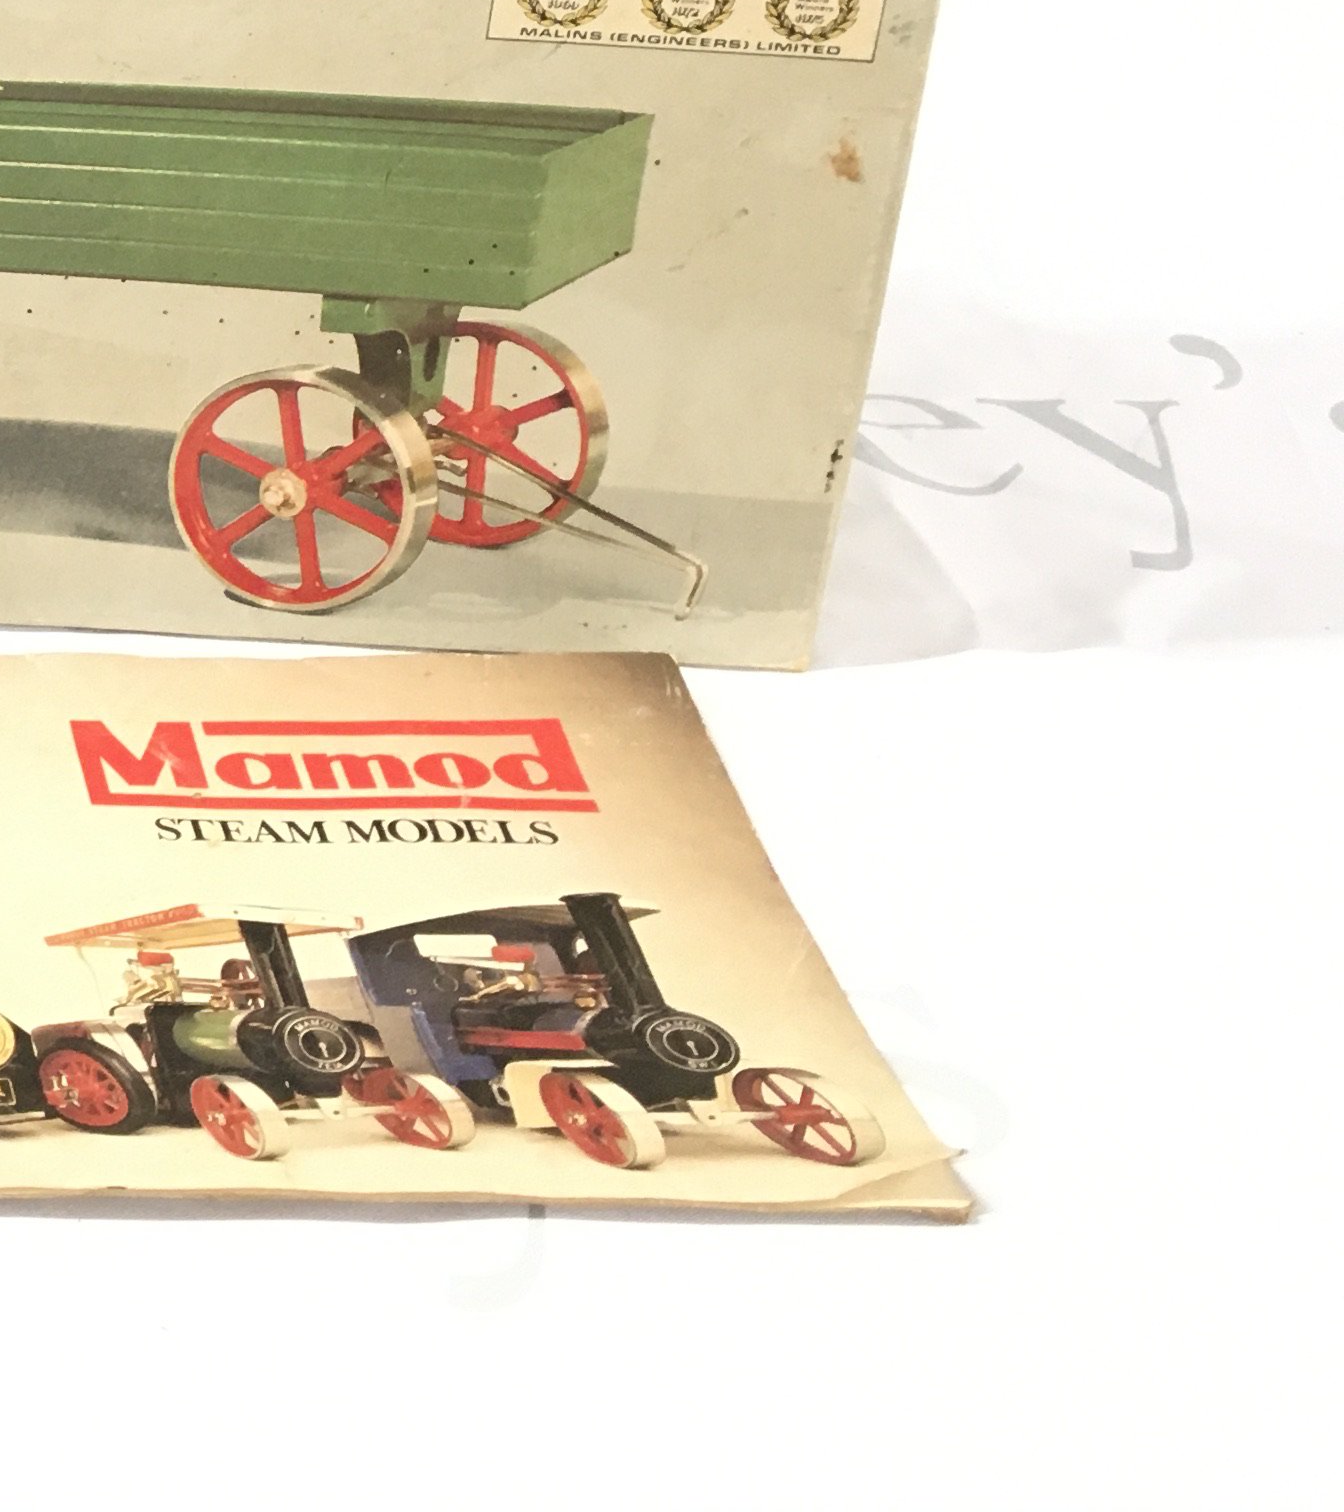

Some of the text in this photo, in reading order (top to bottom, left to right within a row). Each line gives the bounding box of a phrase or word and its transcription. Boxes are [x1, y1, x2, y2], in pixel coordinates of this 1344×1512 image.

[519, 27, 841, 55] MALINS (ENGINEERS) LIMITED
[69, 718, 600, 813] Mamod
[156, 817, 560, 846] STEAM MODELS
